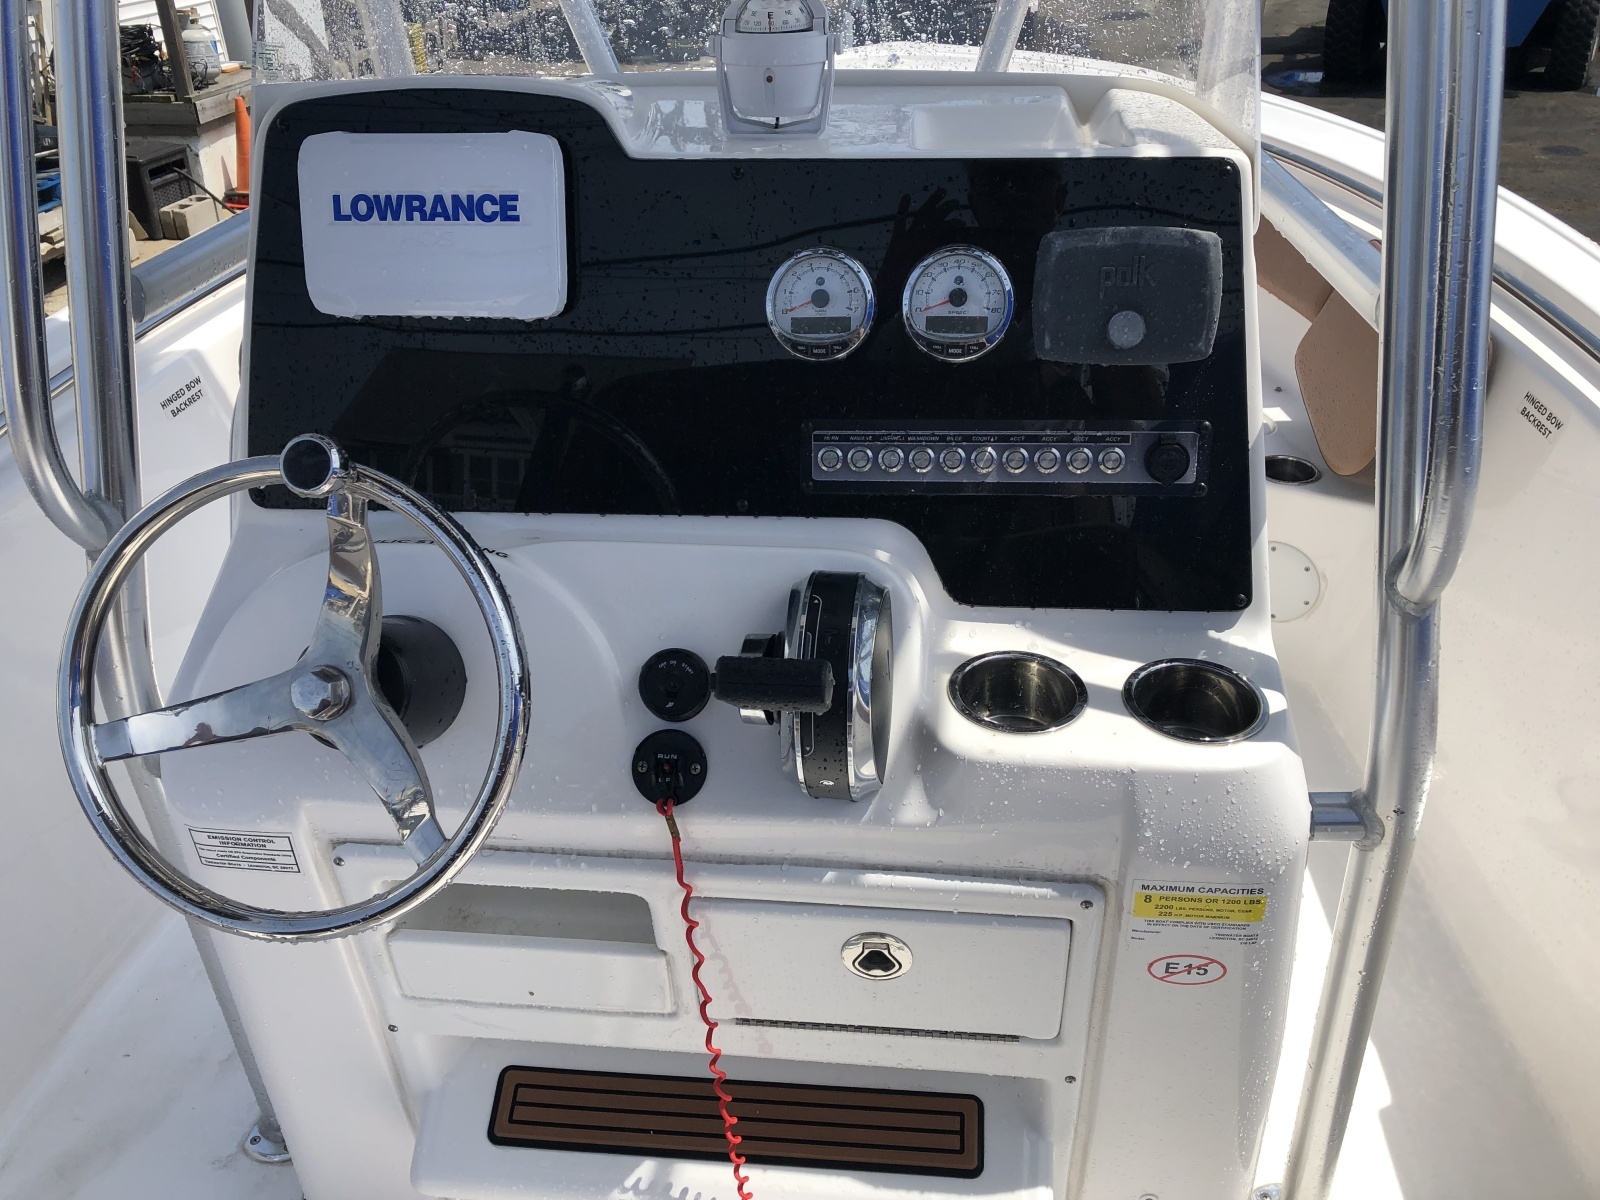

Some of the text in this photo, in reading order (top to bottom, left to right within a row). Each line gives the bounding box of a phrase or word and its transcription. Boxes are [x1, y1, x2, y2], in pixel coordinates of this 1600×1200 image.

[332, 194, 520, 222] LOWRANCE
[1101, 256, 1156, 300] polk
[160, 376, 202, 410] HINGED BOW
[170, 389, 203, 417] BACKREST
[1520, 406, 1552, 438] BACKREST
[1524, 391, 1564, 430] HINGED BOW
[1141, 884, 1264, 895] MAXIMUM CAPACITIES
[1143, 894, 1152, 904] 8
